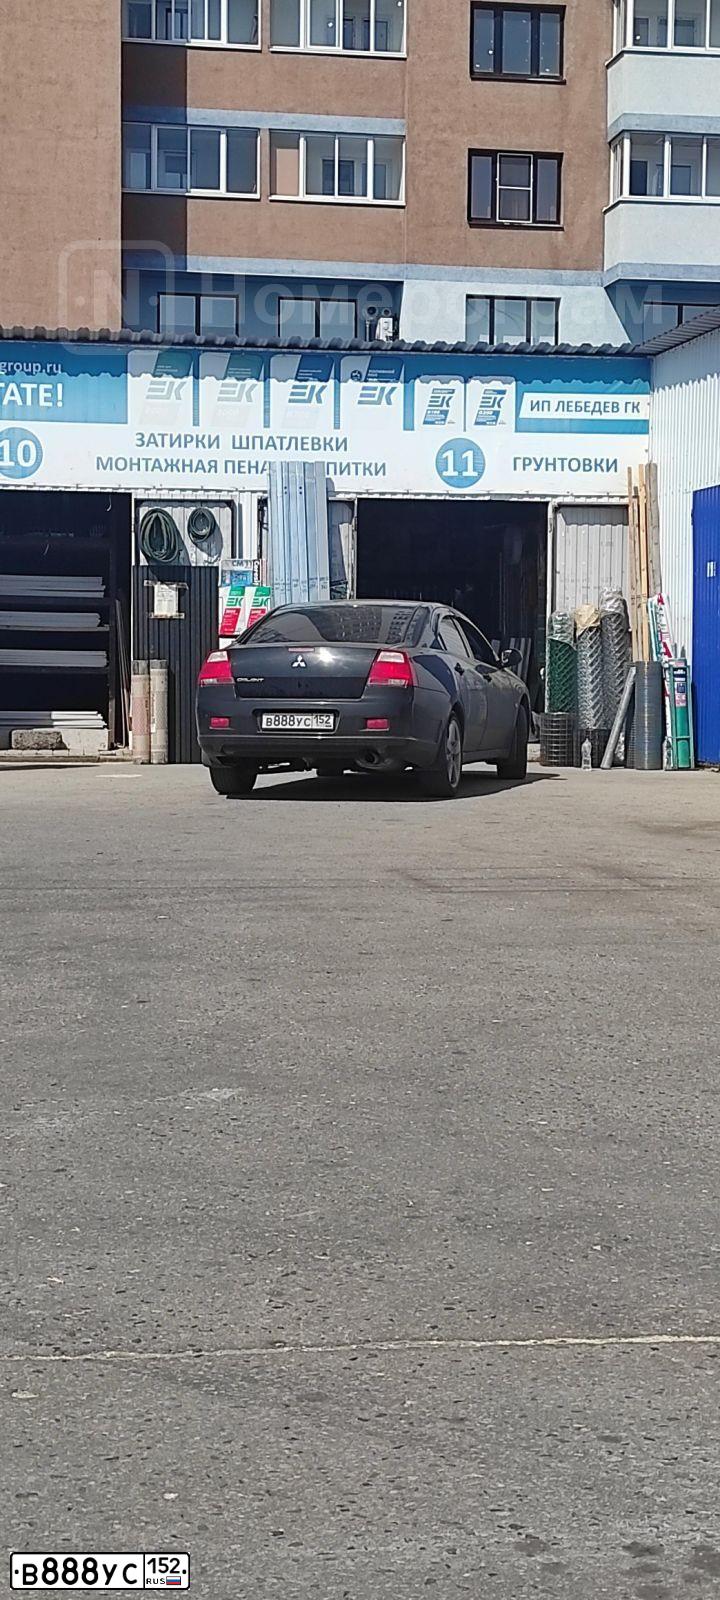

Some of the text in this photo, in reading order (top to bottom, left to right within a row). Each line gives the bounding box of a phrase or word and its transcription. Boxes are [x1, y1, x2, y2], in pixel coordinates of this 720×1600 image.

[529, 399, 641, 415] ИП ЛЕБЕДЕВ ГК
[135, 432, 348, 452] ЗАТИРКИ ШПАТЛЕВКИ
[0, 438, 37, 468] 10
[441, 449, 479, 477] 11
[95, 456, 218, 474] МОНТАЖНАЯ
[326, 461, 387, 477] ПИТКИ
[513, 456, 619, 473] ГРУНТОВКИ
[266, 714, 332, 727] В888УС 152
